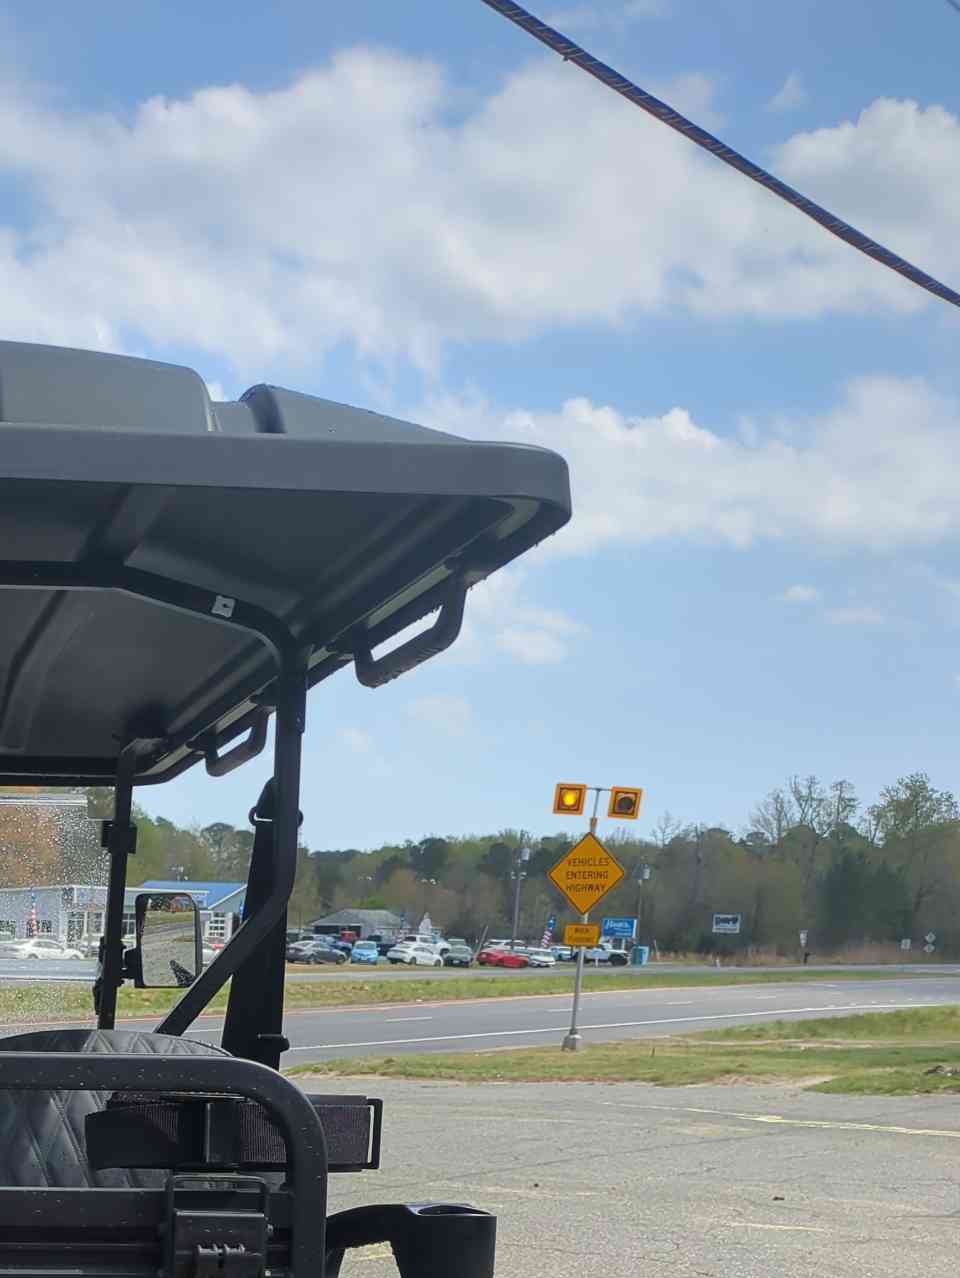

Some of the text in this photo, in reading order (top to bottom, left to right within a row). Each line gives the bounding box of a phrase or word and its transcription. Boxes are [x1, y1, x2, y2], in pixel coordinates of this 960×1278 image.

[567, 857, 609, 867] VEHICLES
[566, 870, 609, 880] ENTERING
[566, 884, 607, 893] HIGHWAY
